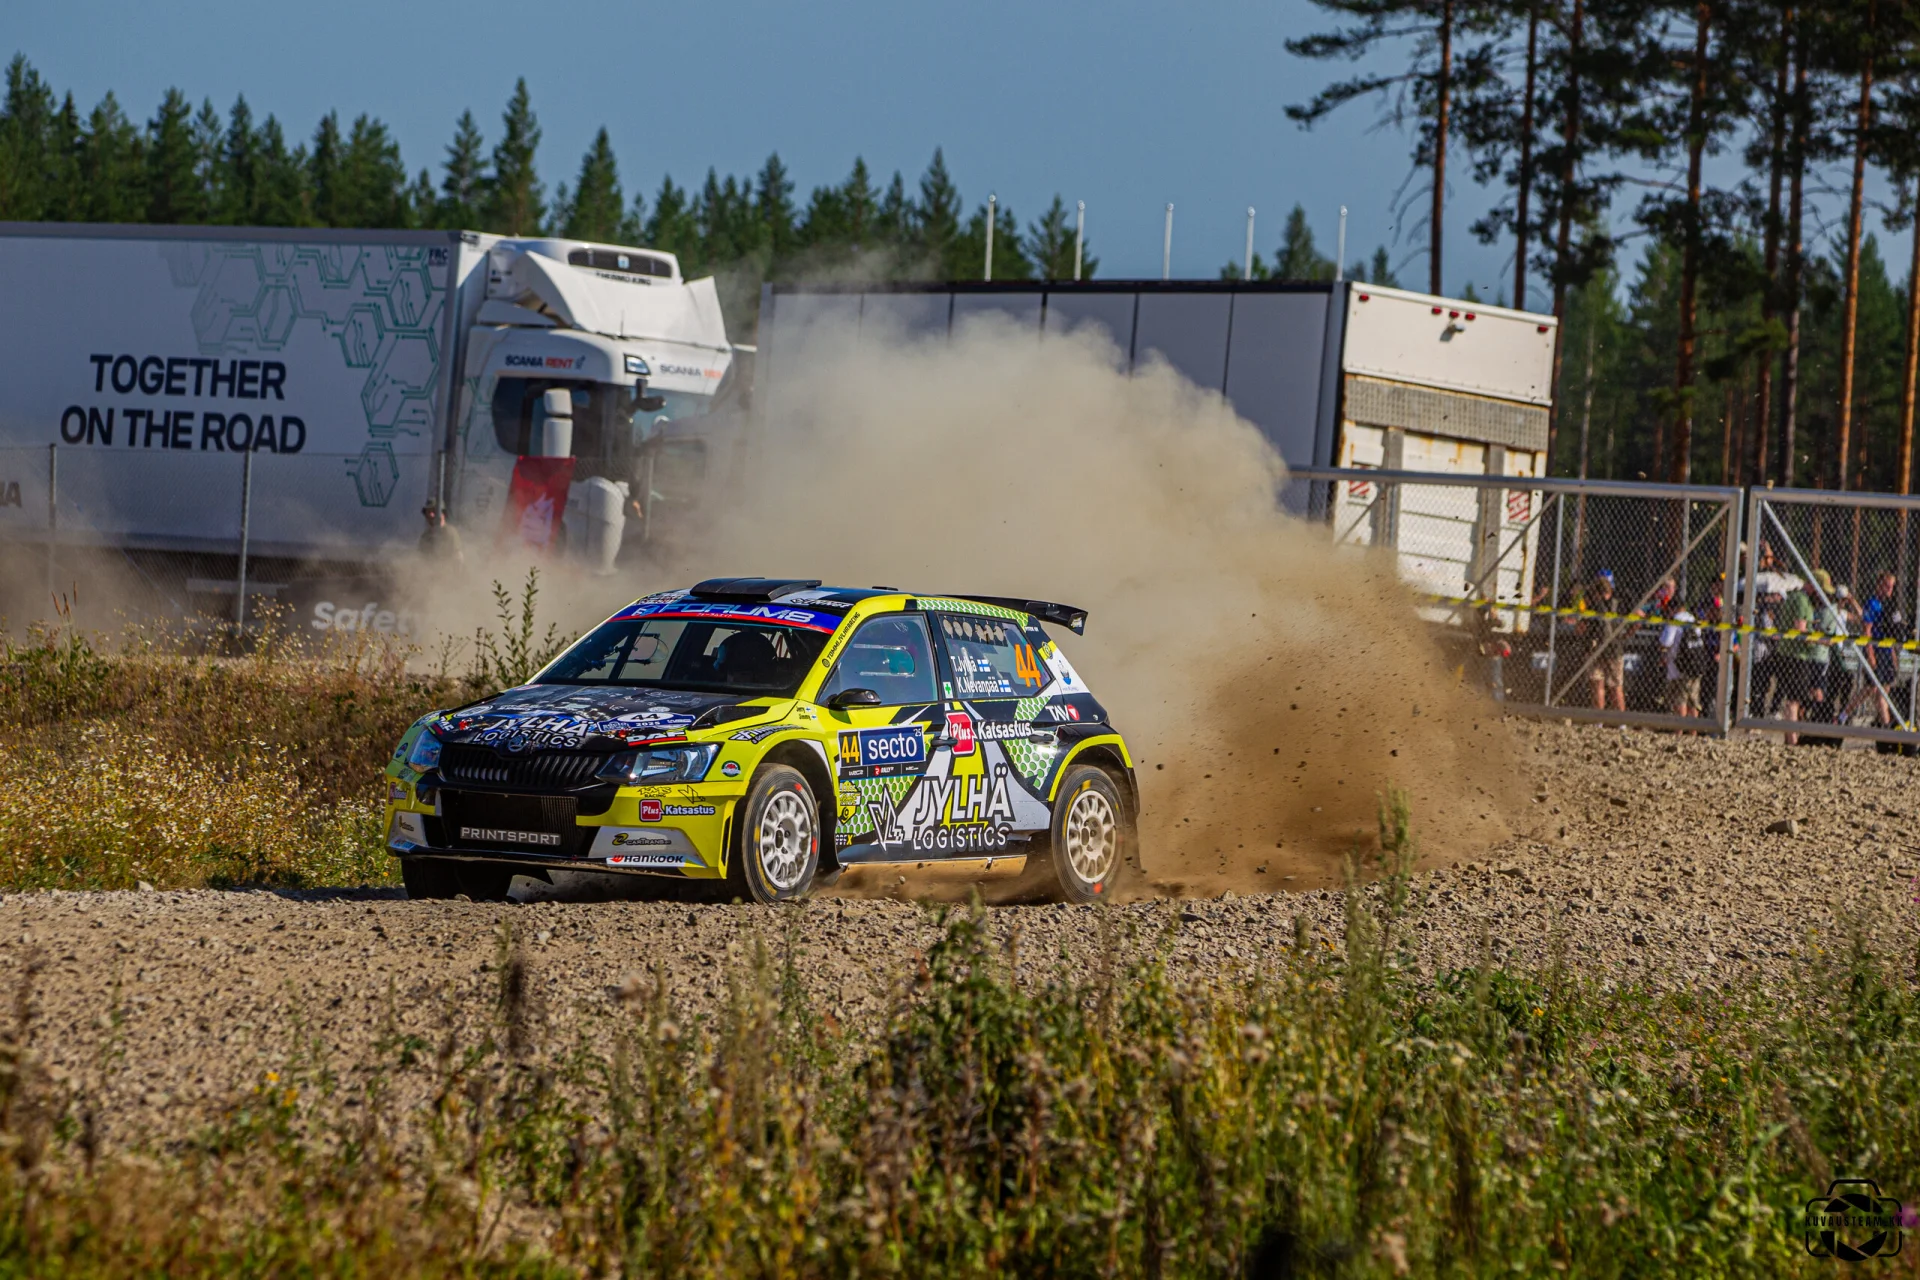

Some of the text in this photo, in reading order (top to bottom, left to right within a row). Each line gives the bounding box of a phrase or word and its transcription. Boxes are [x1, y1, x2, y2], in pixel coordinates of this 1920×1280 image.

[505, 354, 574, 369] SCANIA RENT
[90, 353, 287, 400] TOGETHER
[60, 405, 307, 454] ON THE ROAD
[658, 603, 815, 623] FORUM8
[1015, 643, 1042, 687] 44
[482, 716, 590, 737] JYLHÄ
[631, 713, 661, 721] 44
[473, 730, 579, 748] LOGISTICS
[951, 720, 1031, 740] Plus Katsastus
[841, 733, 917, 764] 44 secto
[915, 766, 1011, 821] JYLHÄ
[642, 805, 714, 815] Plus Katsastus
[461, 827, 560, 845] PRINTSPORT
[913, 826, 1010, 850] LOGISTICS
